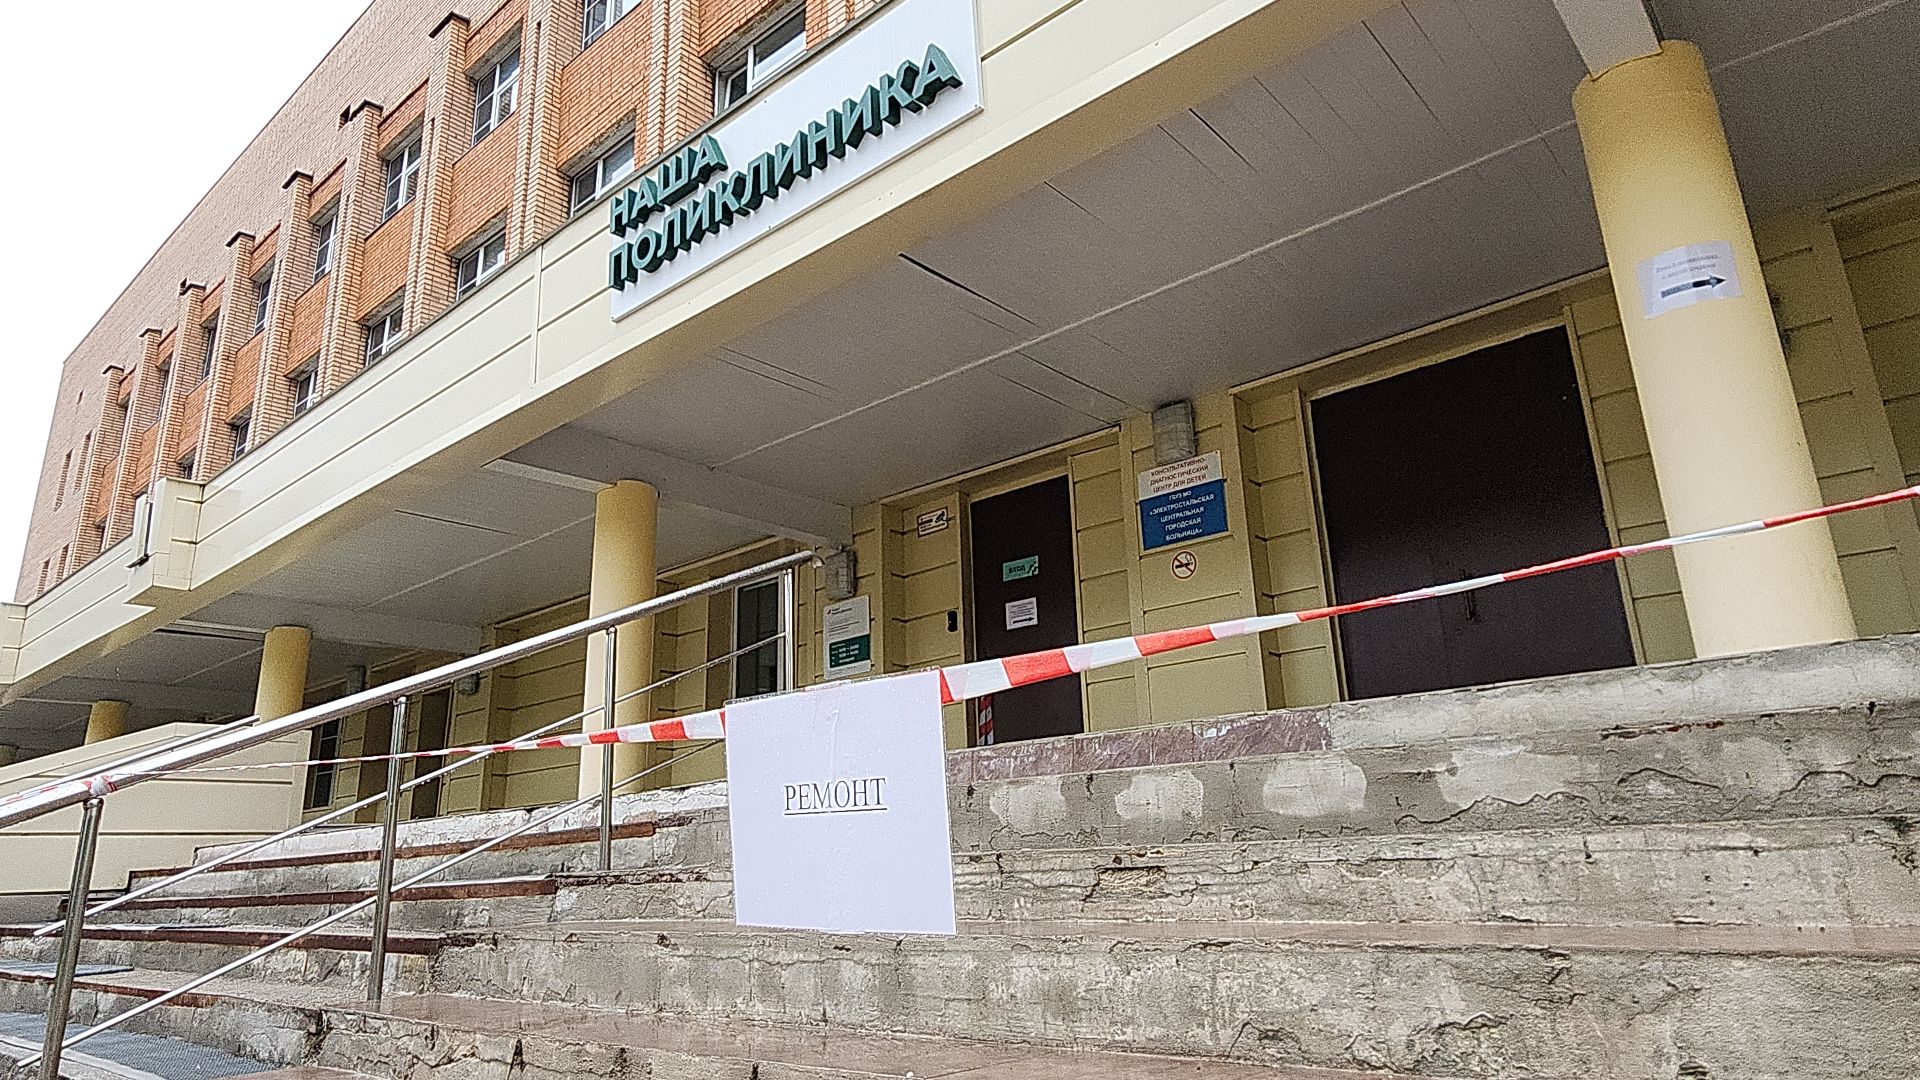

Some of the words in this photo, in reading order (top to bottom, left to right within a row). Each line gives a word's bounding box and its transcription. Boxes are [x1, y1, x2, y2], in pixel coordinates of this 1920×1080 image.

[609, 43, 963, 291] ПОЛИКЛИНИКА
[610, 133, 728, 237] НАША
[1150, 465, 1208, 486] ДИАГНОСТИЧЕСКИЙ
[1153, 483, 1172, 493] ЦЕНТР
[1173, 479, 1185, 488] ДЛЯ
[1187, 473, 1207, 484] ДЕТЕЙ
[1160, 507, 1204, 522] ЦЕНТРАЛЬНАЯ
[1165, 517, 1201, 531] ГОРОДСКАЯ
[784, 777, 887, 812] РЕМОНТ
